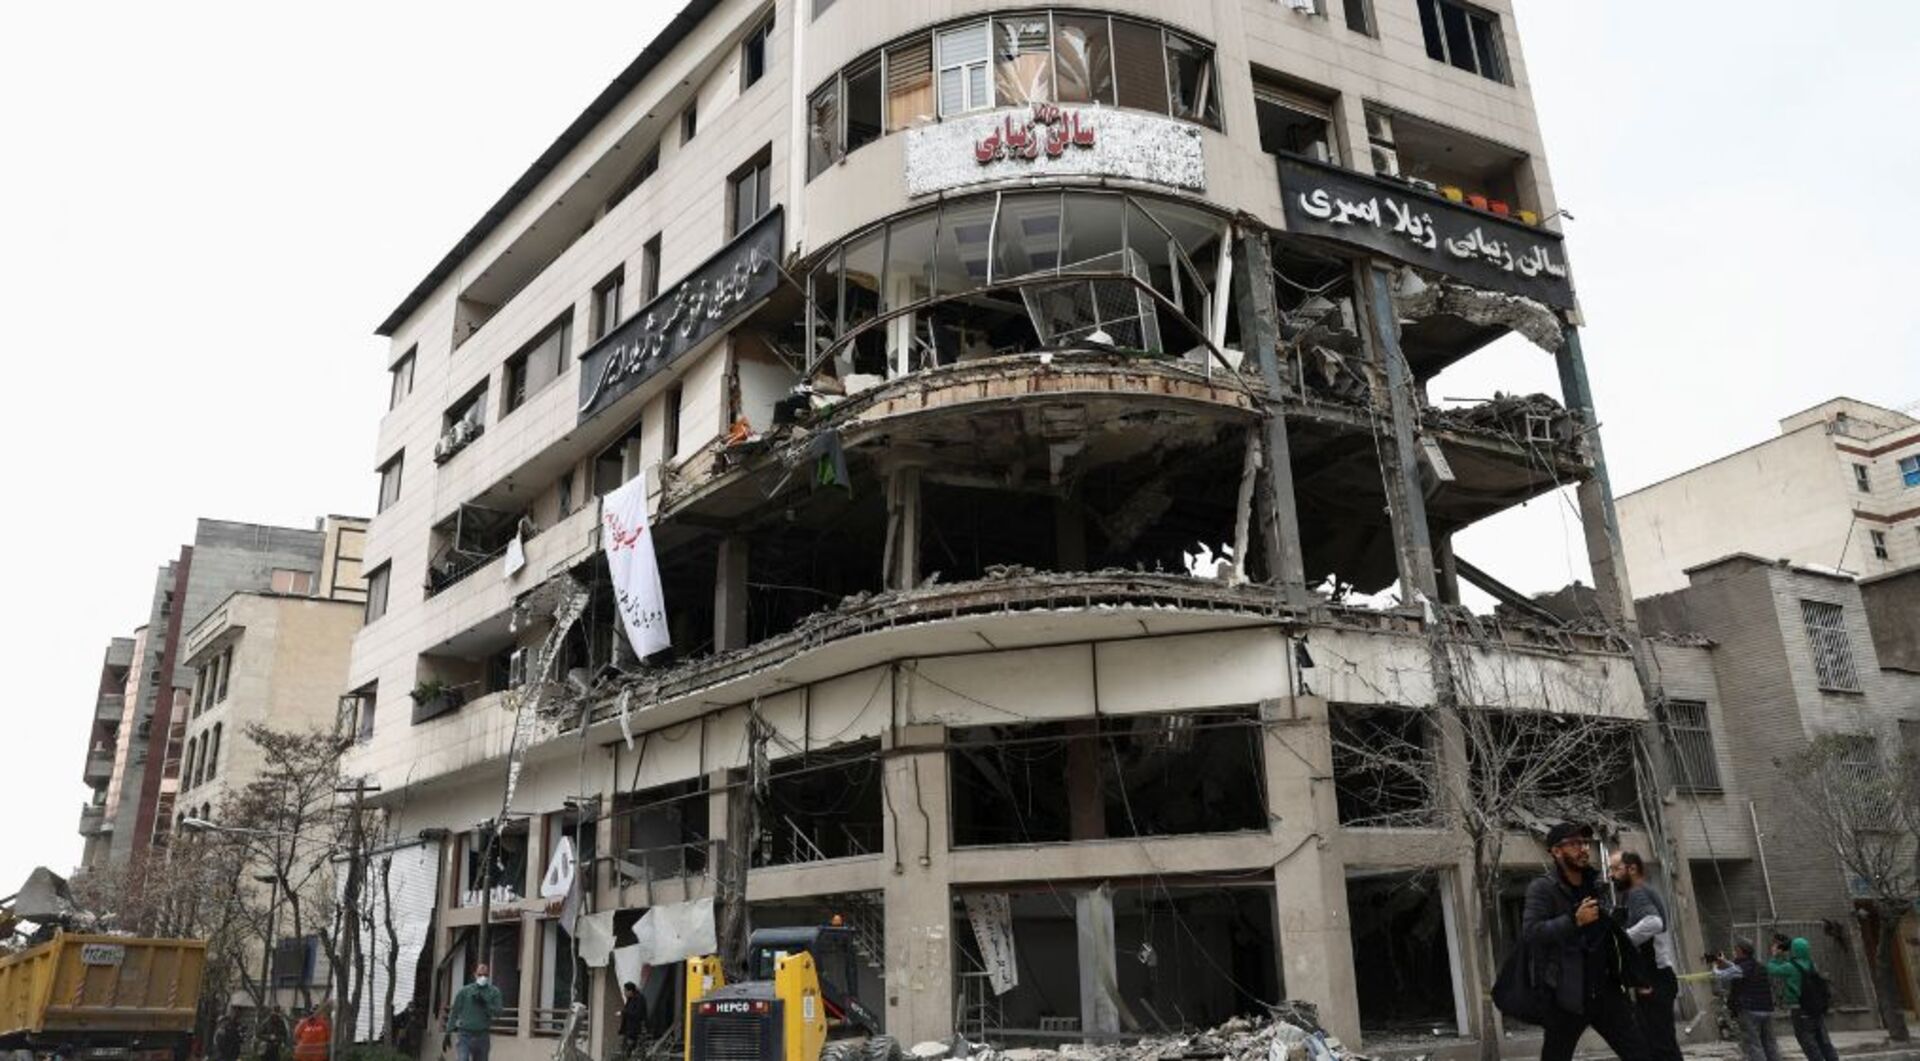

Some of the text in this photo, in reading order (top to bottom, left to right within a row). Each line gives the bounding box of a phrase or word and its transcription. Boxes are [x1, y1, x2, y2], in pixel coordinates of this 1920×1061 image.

[975, 110, 1096, 163] سالن زیبایی
[1300, 187, 1566, 278] سالن زیبایی ژیلا امیری
[716, 1001, 750, 1013] HEPCO
